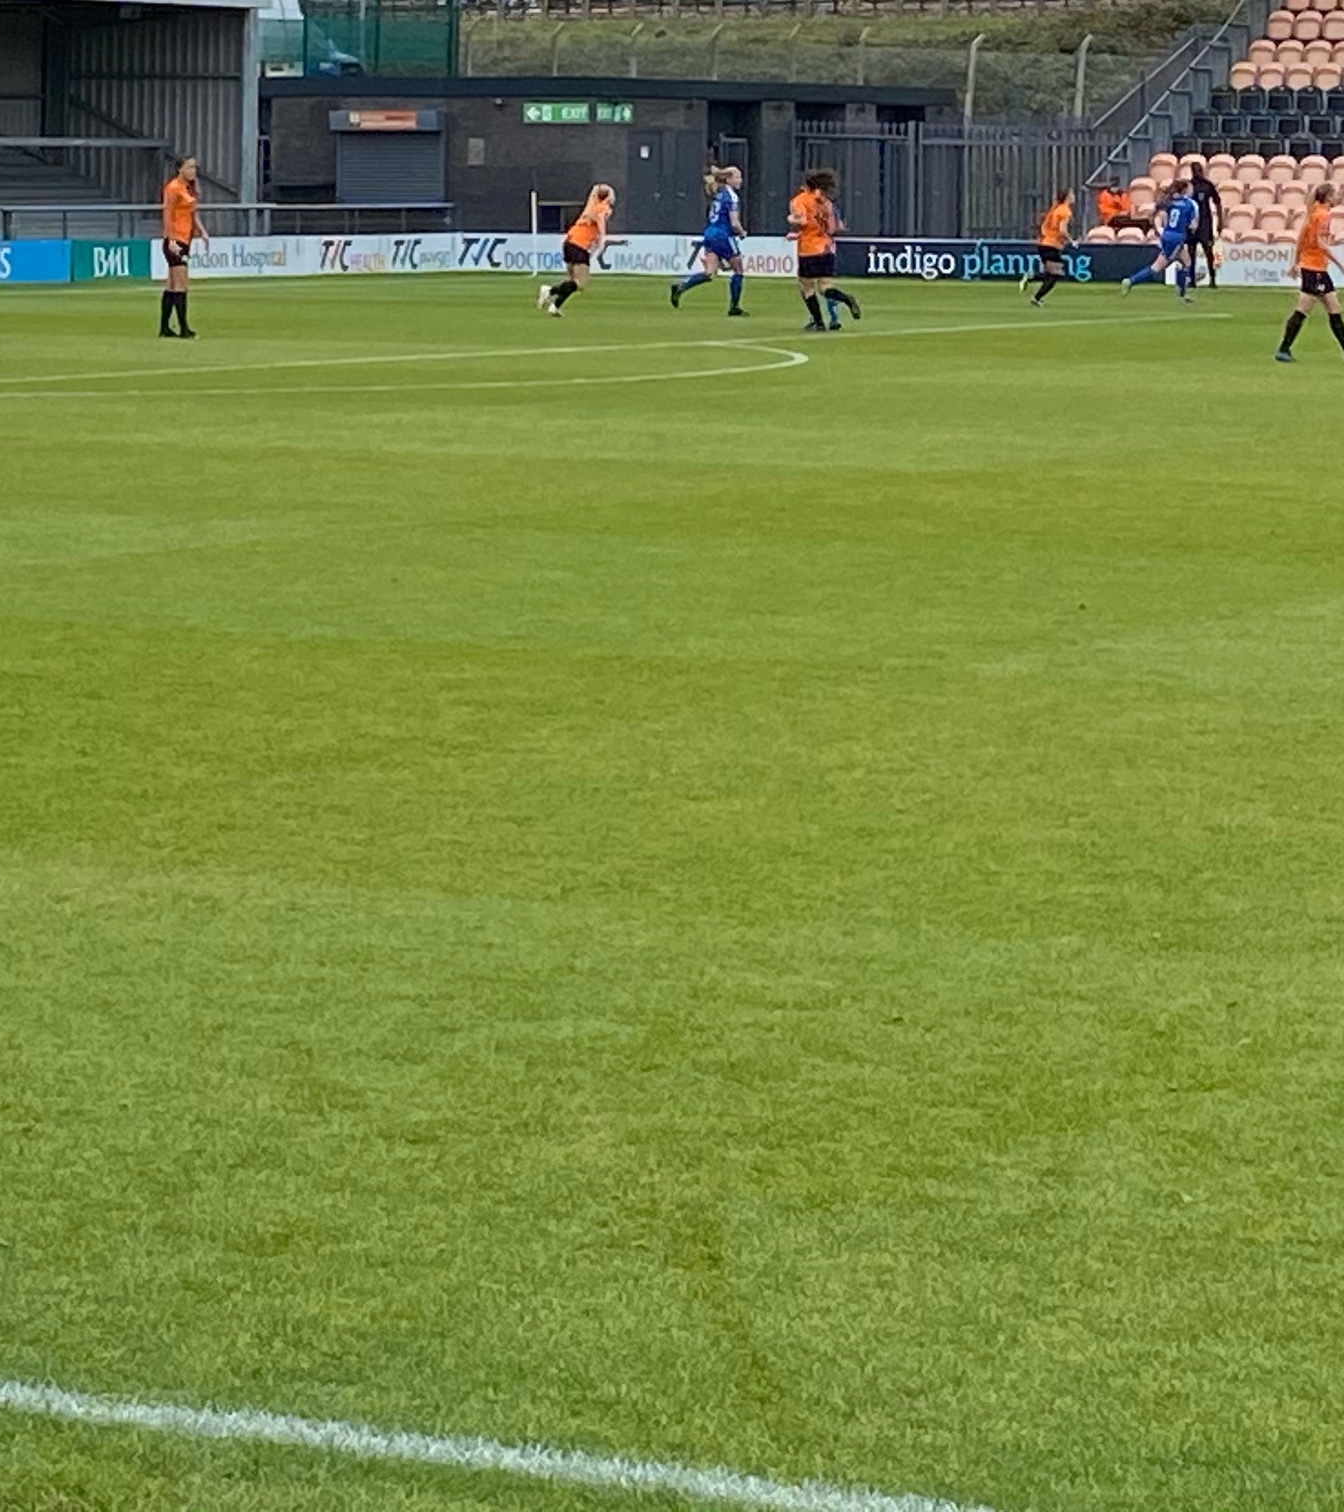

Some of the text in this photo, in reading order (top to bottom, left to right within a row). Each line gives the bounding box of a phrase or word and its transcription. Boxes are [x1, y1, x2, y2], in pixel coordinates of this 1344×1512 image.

[93, 246, 130, 278] BMI
[613, 252, 682, 271] IMAGING
[867, 245, 955, 280] indigo
